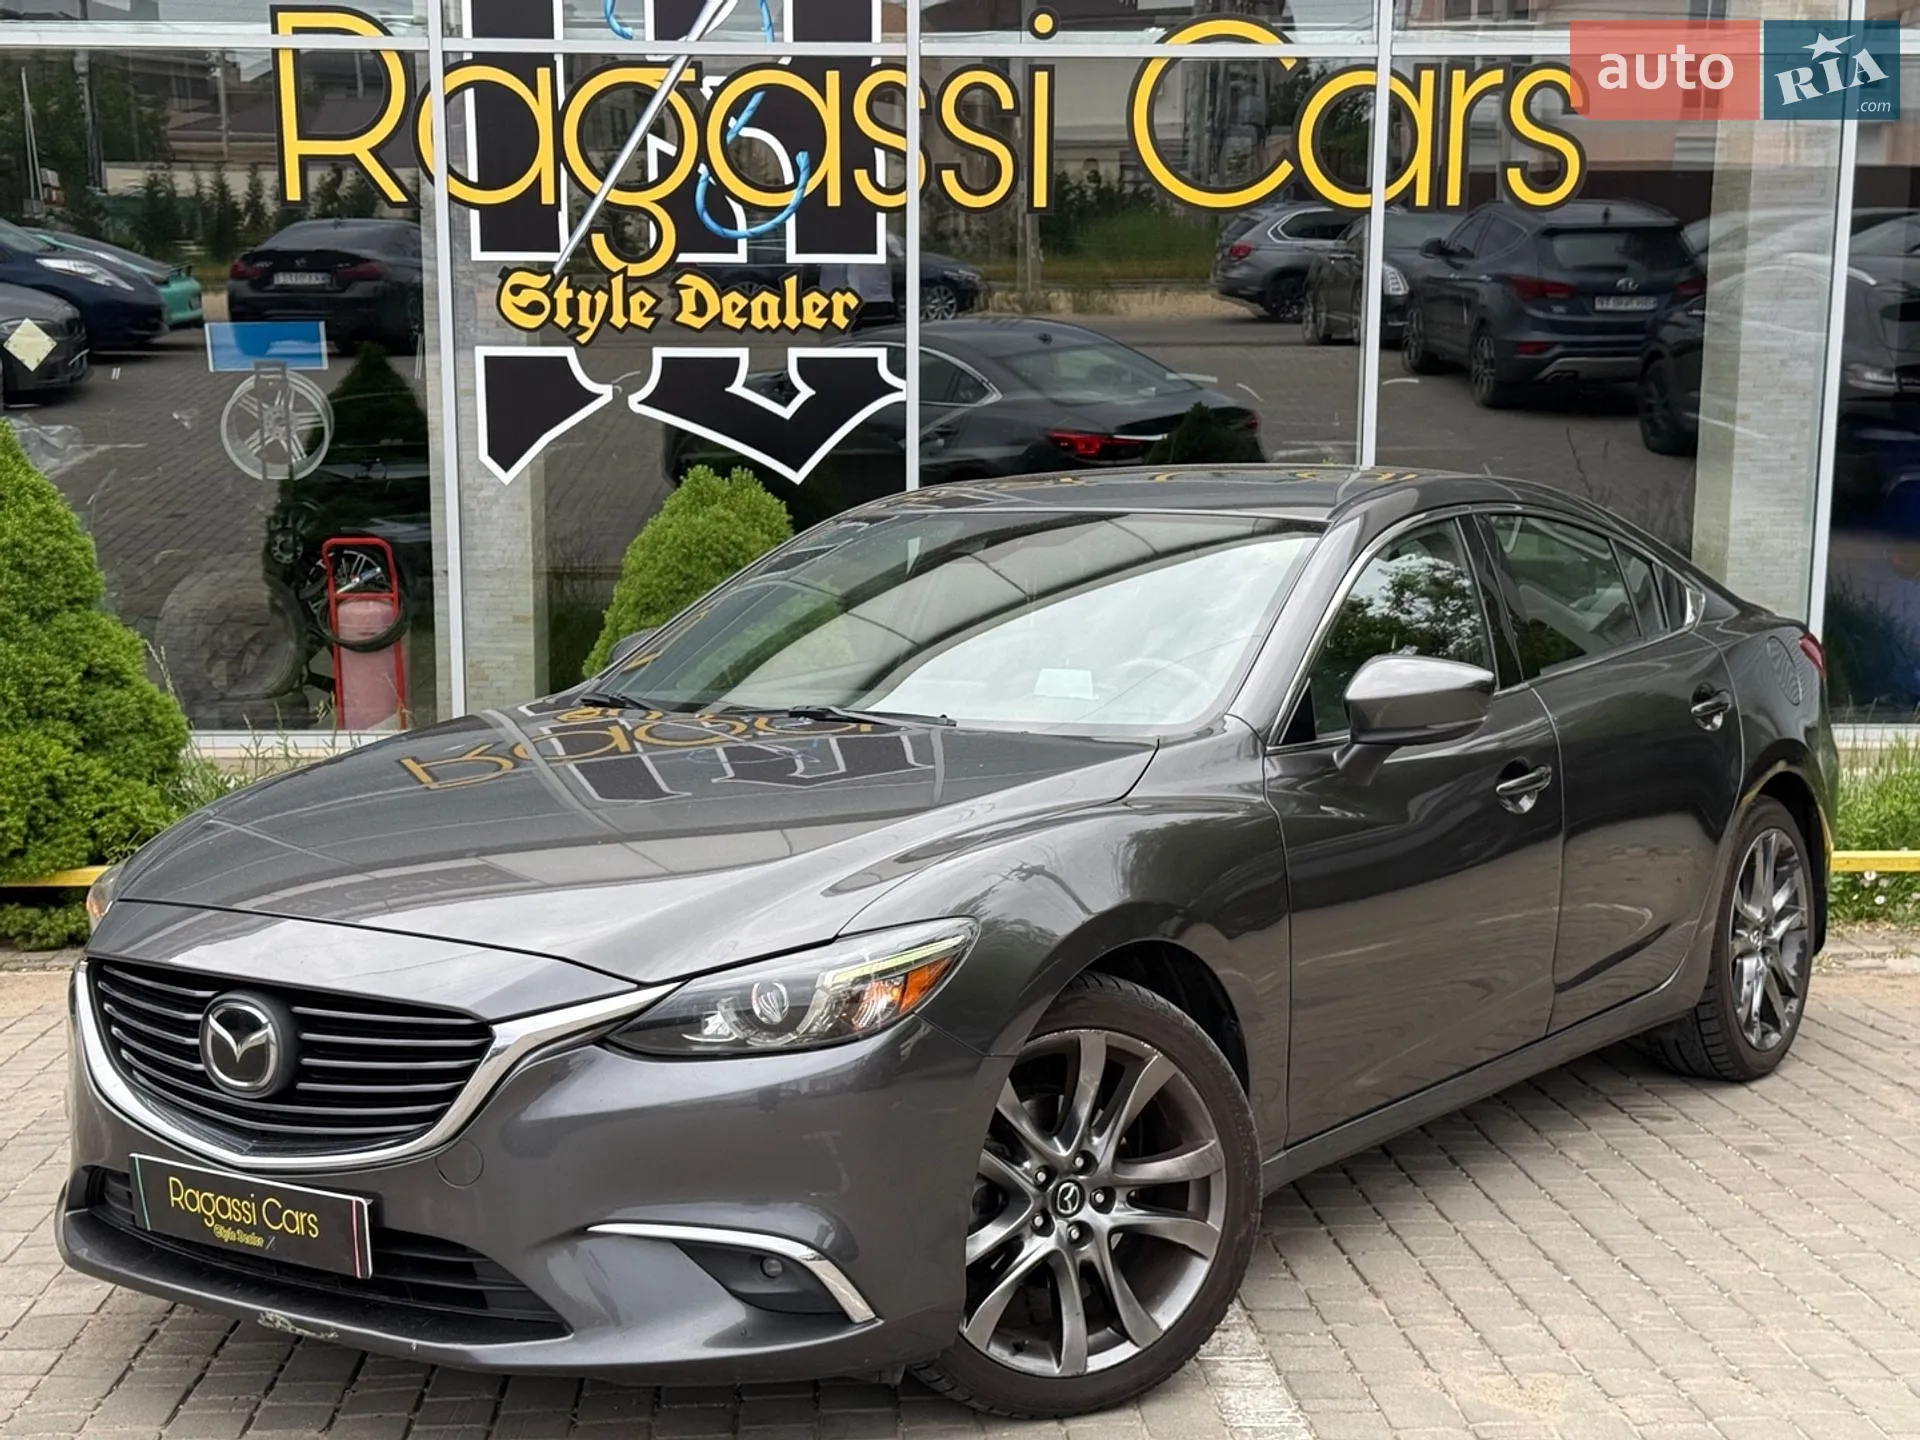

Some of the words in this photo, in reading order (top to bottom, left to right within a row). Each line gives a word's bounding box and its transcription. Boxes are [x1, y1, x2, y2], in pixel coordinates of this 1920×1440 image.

[271, 6, 1055, 281] Ragassi
[1128, 14, 1589, 211] Cars
[499, 268, 660, 346] Style
[673, 271, 860, 333] Dealer
[168, 1176, 257, 1228] Ragassi
[262, 1197, 320, 1239] Cars
